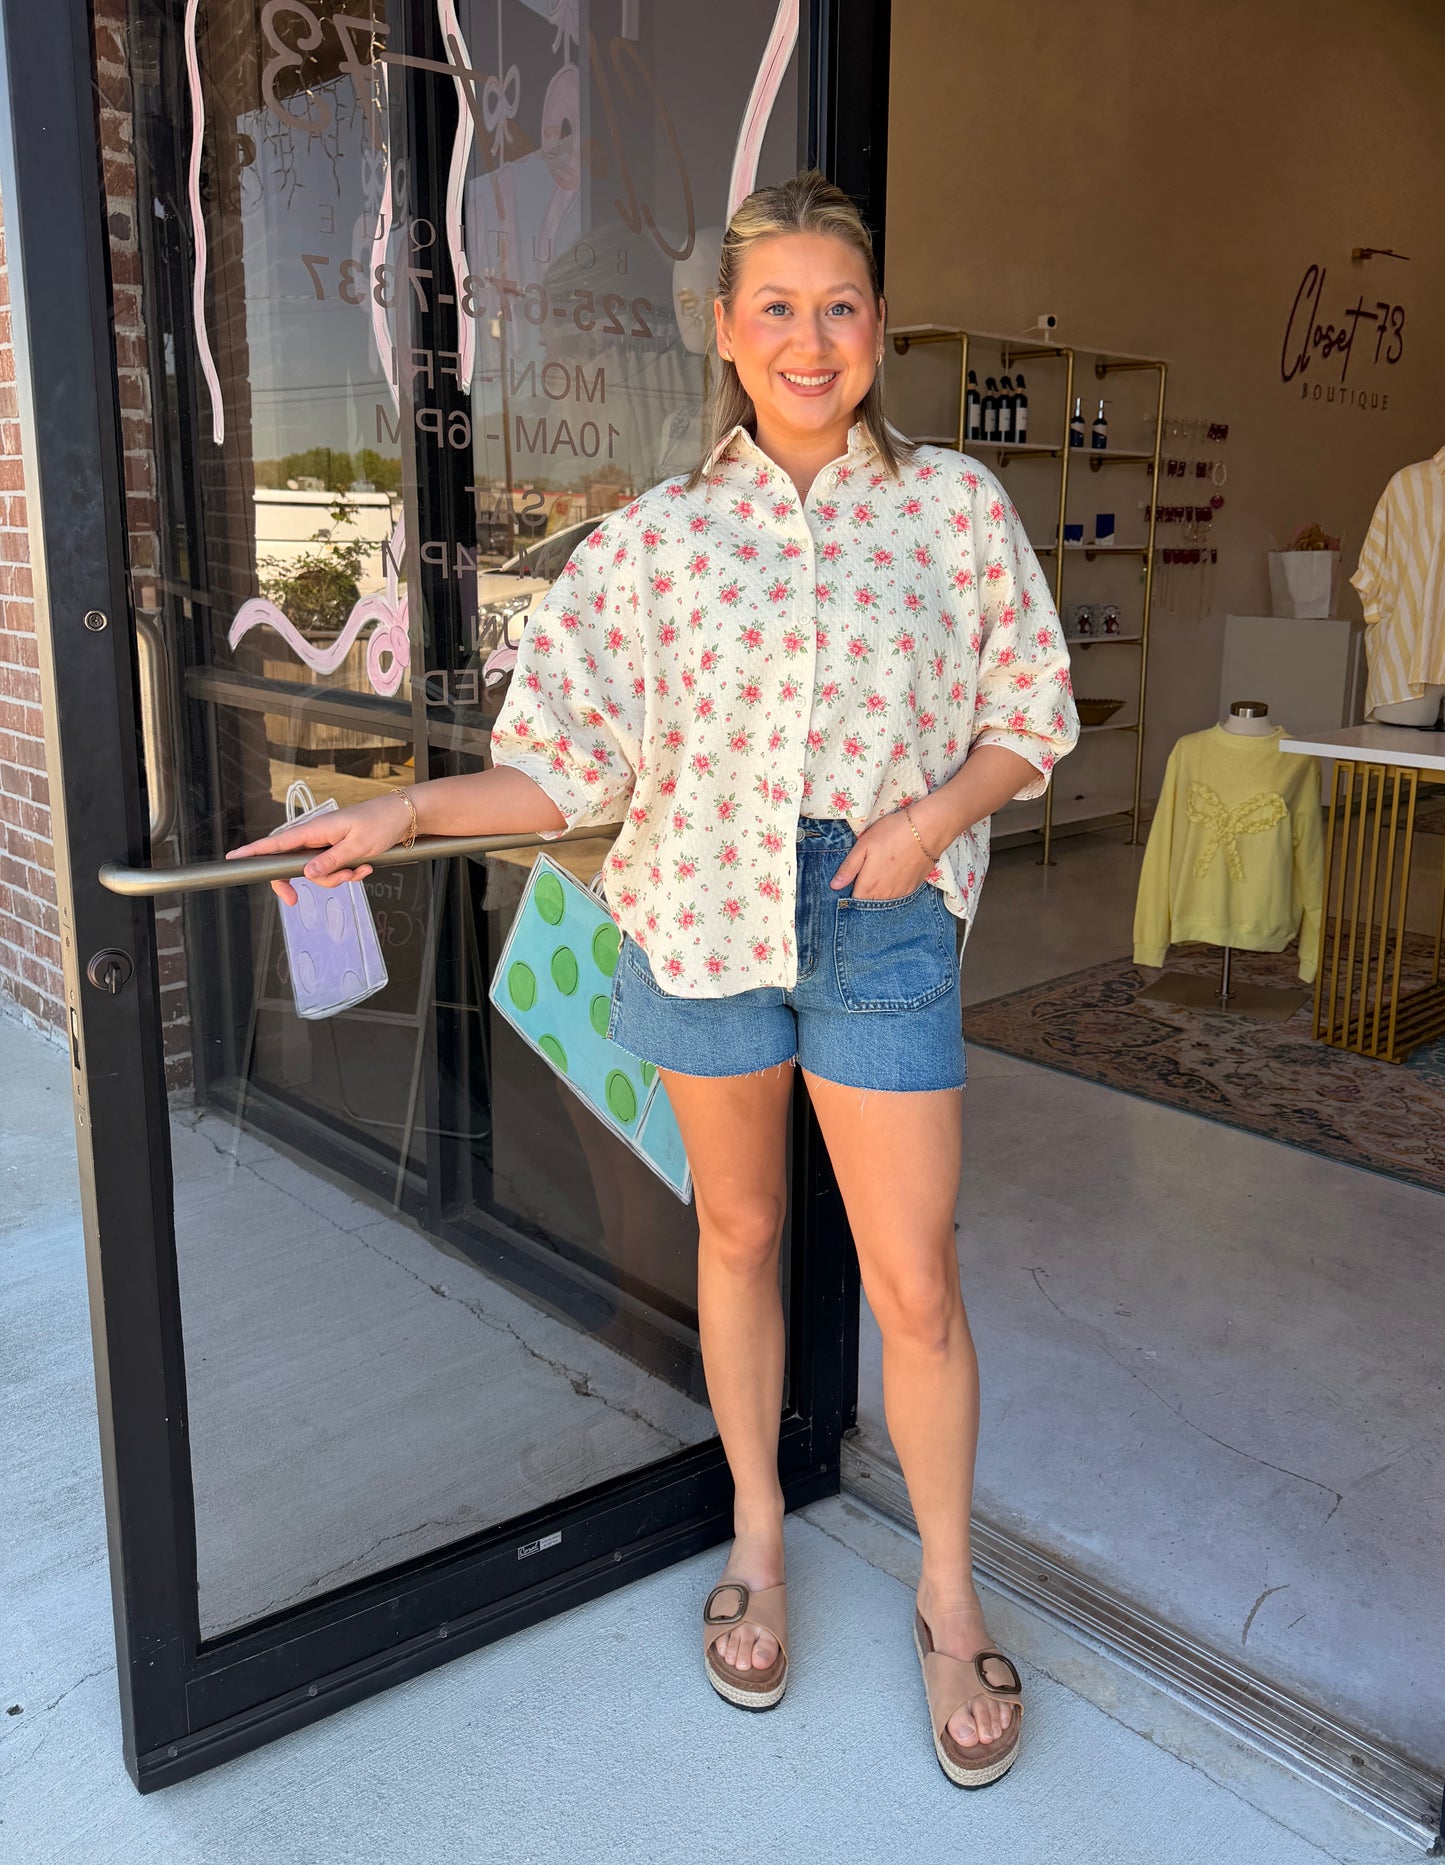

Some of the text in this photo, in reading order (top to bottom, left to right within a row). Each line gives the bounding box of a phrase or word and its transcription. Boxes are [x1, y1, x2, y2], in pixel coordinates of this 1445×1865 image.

[1281, 264, 1405, 383] Closet 73
[1301, 382, 1389, 410] BOUTIQUE
